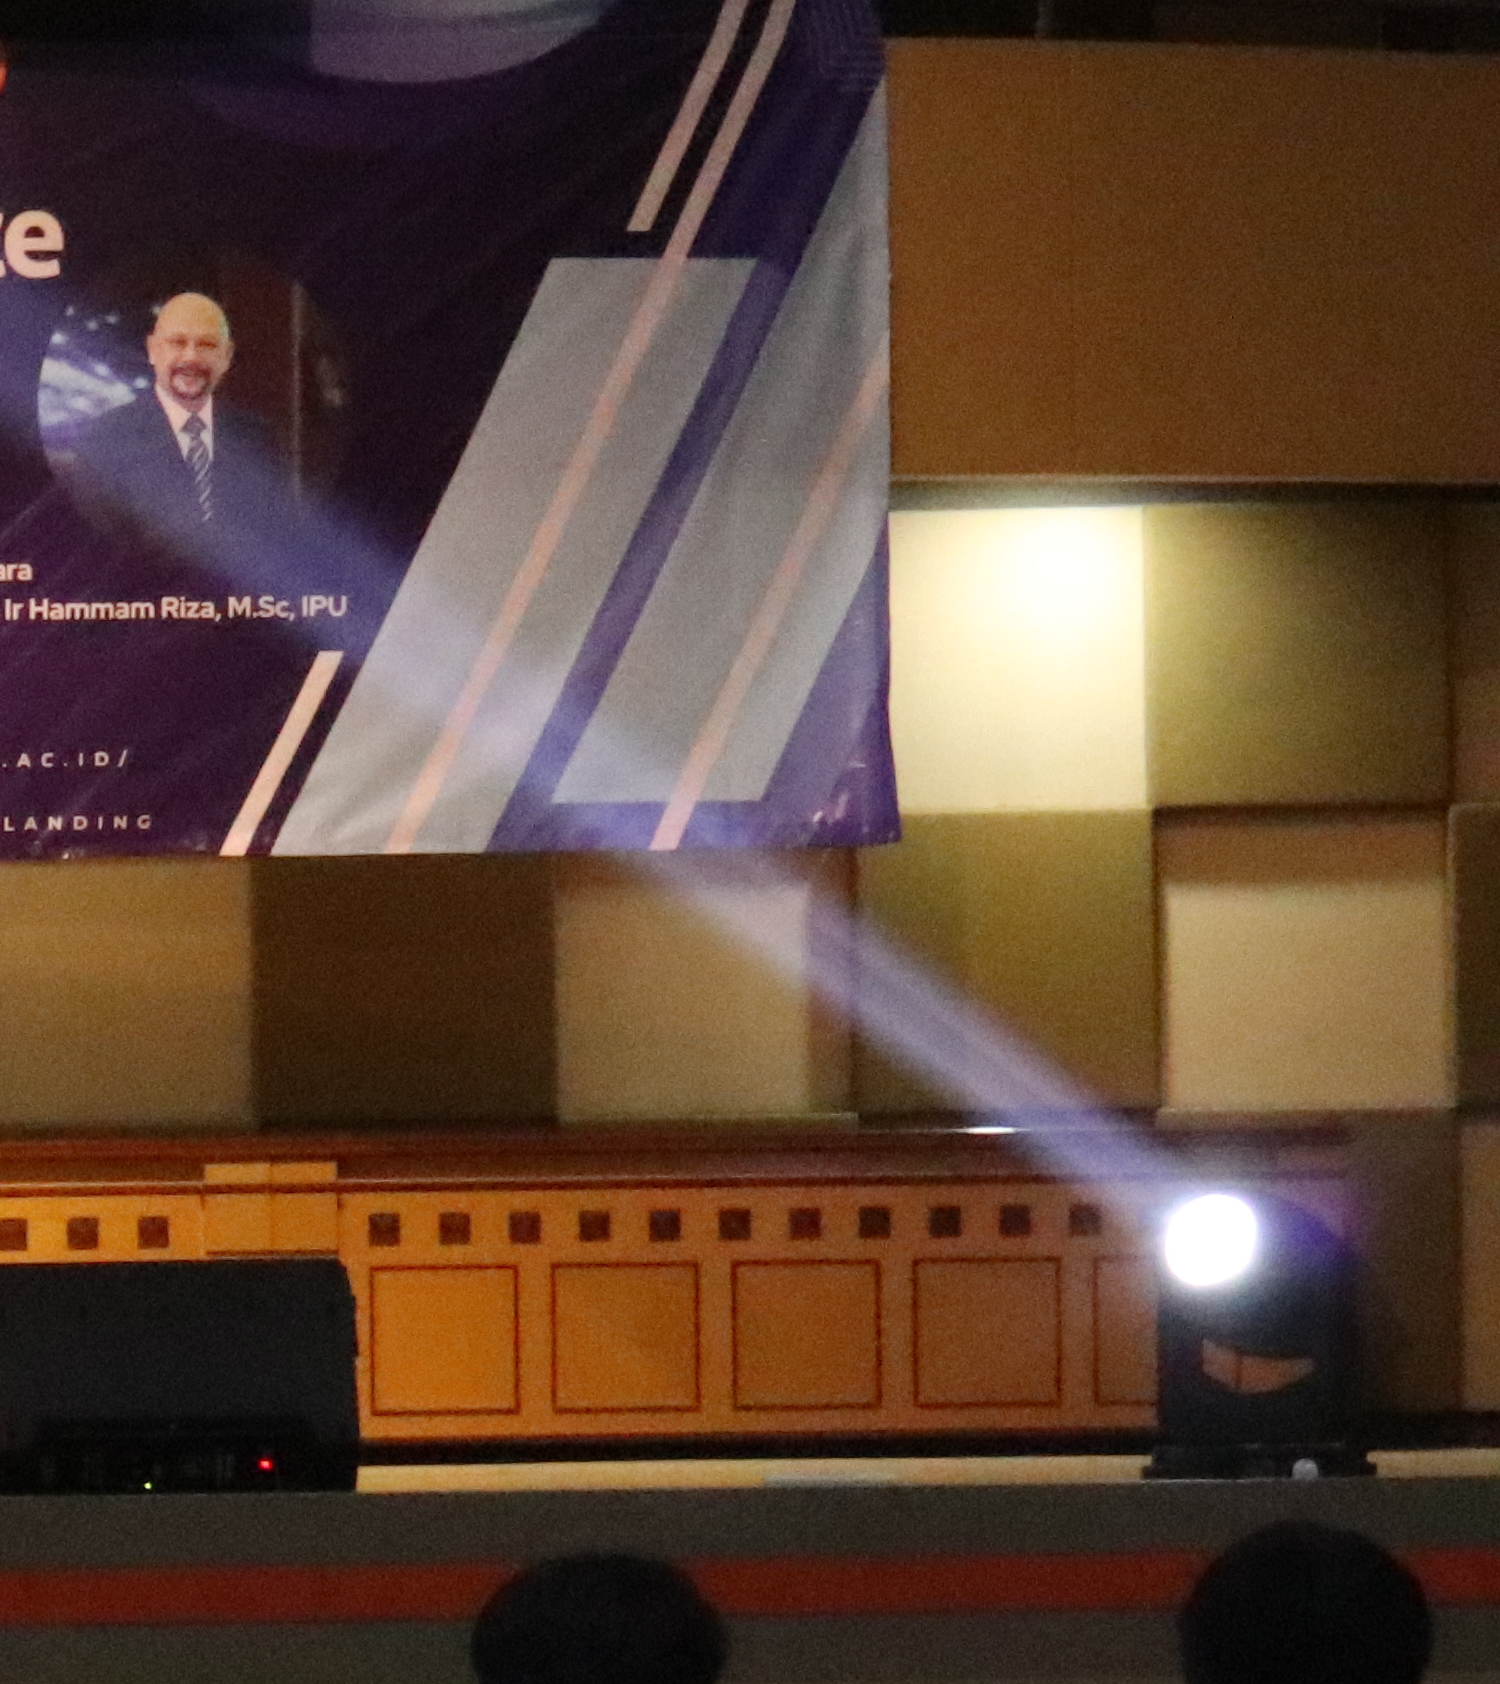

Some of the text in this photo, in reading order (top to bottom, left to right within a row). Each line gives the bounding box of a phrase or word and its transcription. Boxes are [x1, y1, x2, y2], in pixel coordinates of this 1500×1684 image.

[3, 598, 24, 621] Ir
[28, 597, 155, 621] Hammam
[159, 595, 221, 623] Riza,
[226, 595, 297, 622] M.Sc,
[301, 595, 348, 617] IPU
